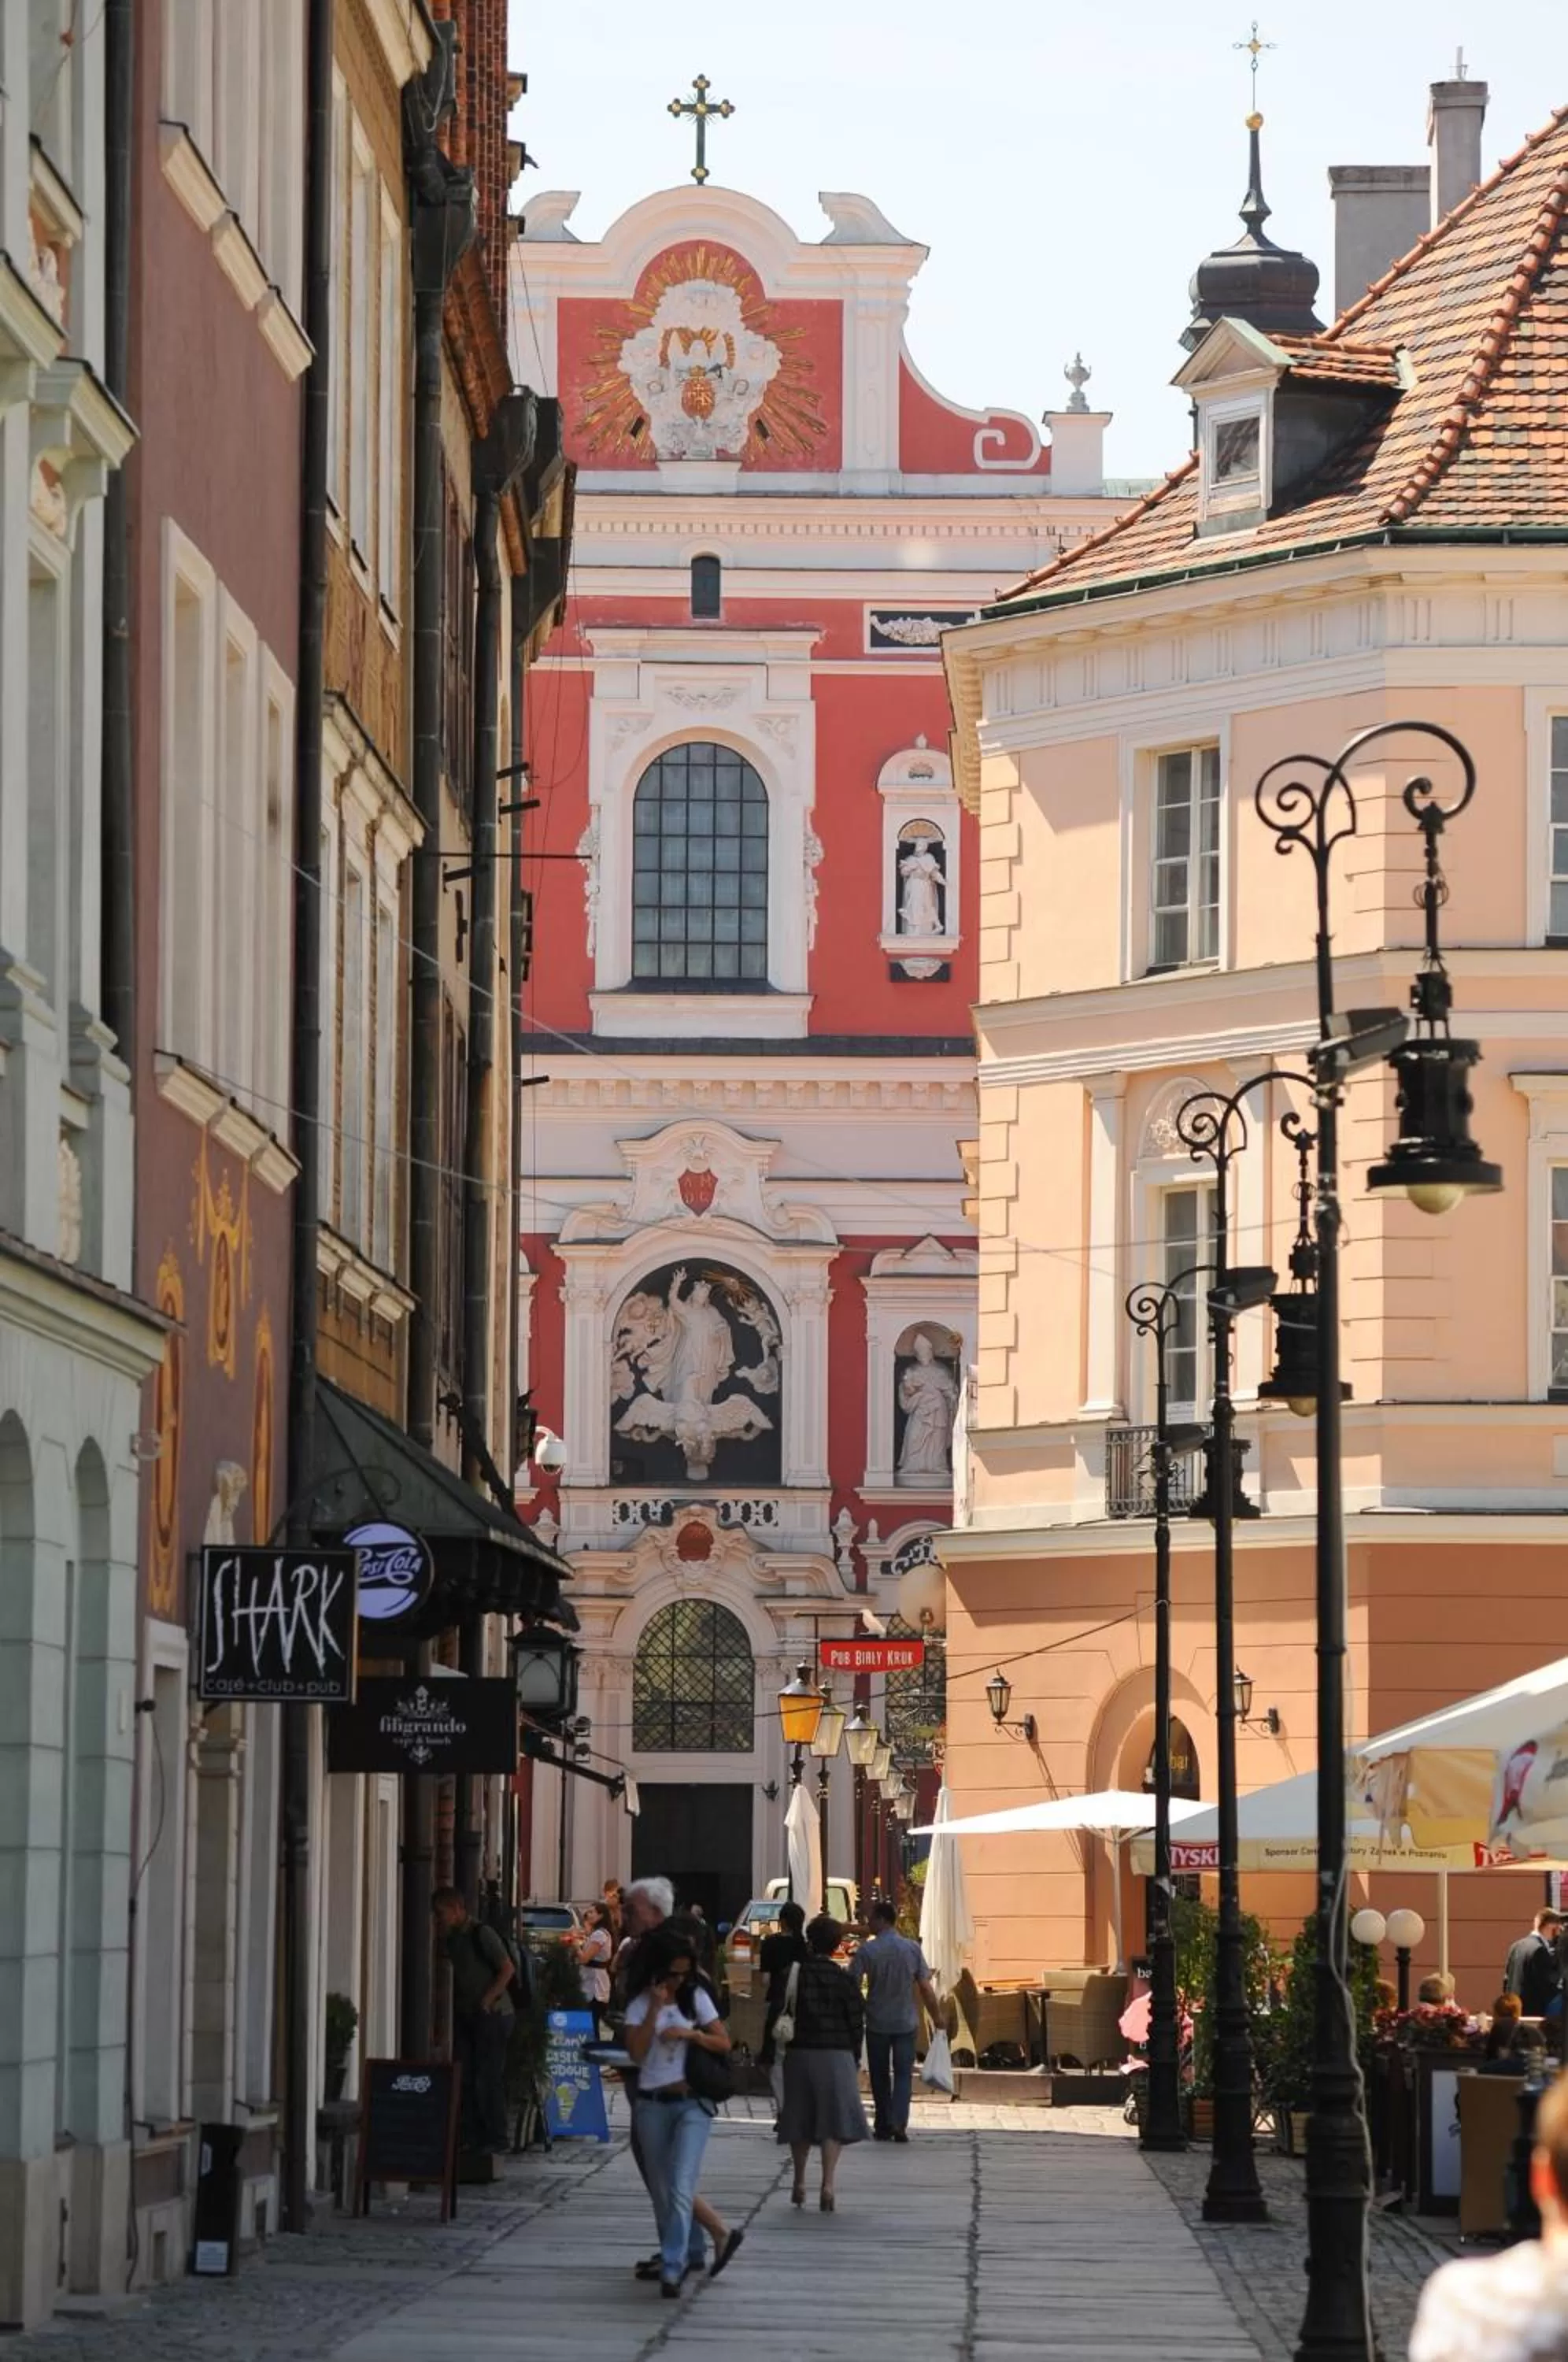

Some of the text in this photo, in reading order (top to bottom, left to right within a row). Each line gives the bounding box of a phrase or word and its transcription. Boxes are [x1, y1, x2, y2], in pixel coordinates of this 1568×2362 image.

[206, 1556, 346, 1677] SHARK
[379, 1716, 467, 1736] filigrando
[1170, 1846, 1219, 1867] TYSKI
